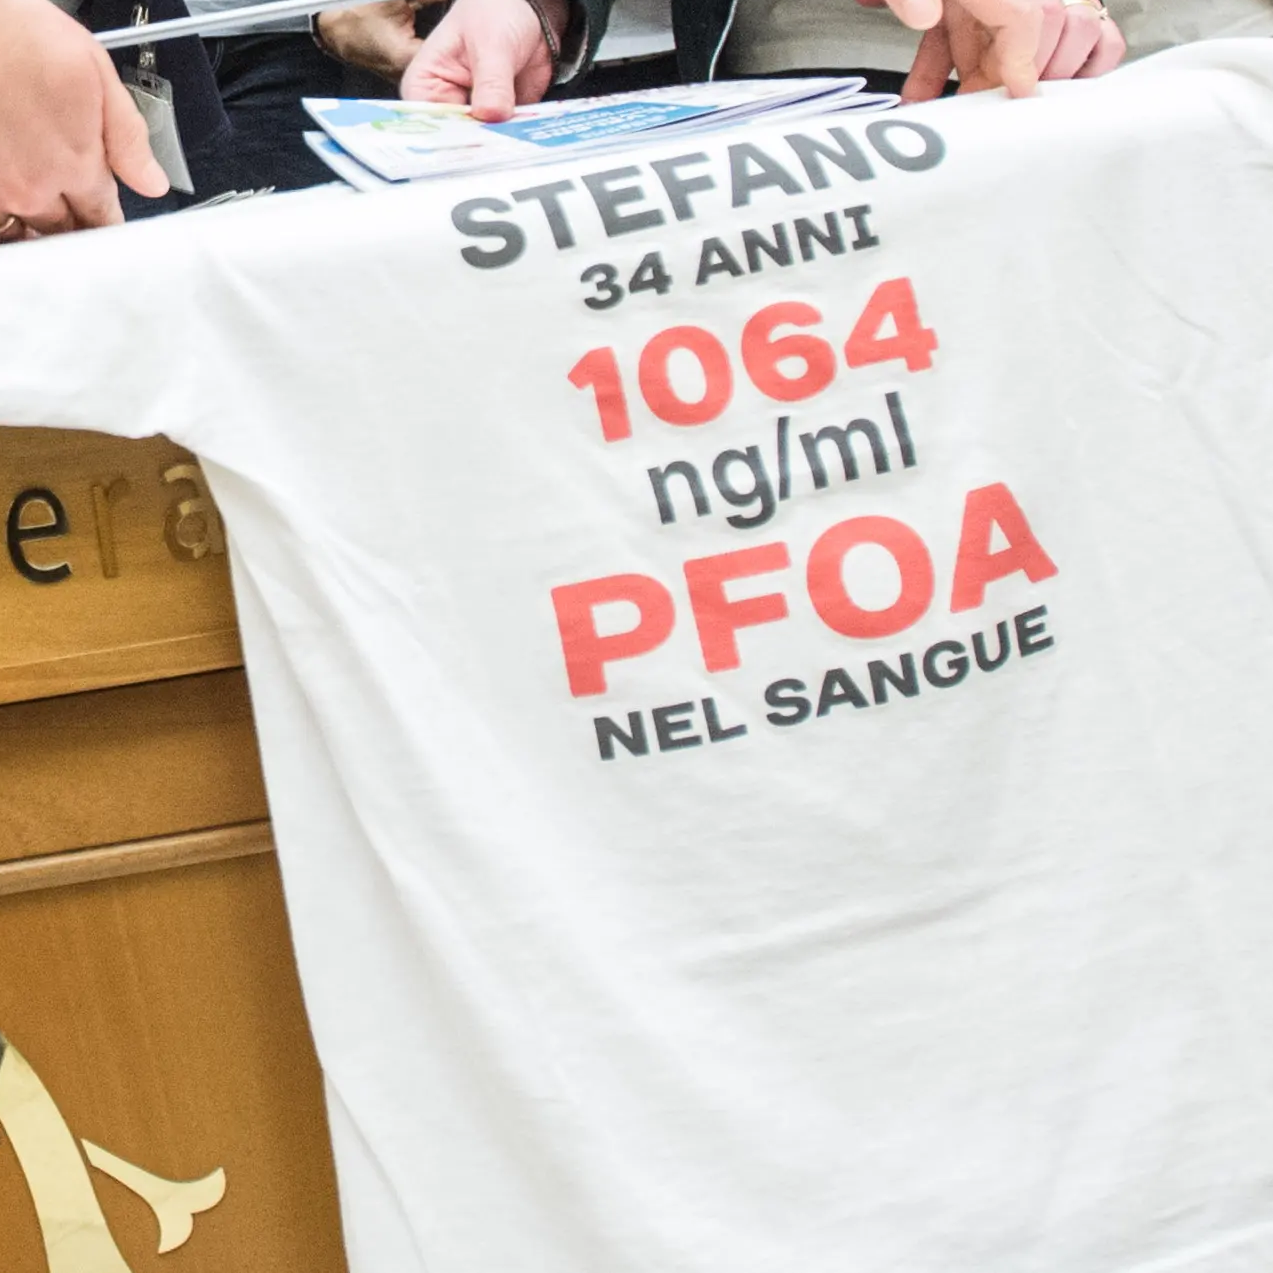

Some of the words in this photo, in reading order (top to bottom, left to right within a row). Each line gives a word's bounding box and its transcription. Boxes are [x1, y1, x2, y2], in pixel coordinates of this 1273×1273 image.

[450, 118, 946, 269] STEFANO
[580, 251, 671, 310] 34
[695, 204, 879, 285] ANNI
[568, 278, 936, 441] 1064
[648, 392, 915, 529] ng/ml
[552, 483, 1056, 696] PFOA
[594, 698, 746, 760] NEL
[765, 606, 1053, 725] SANGUE
